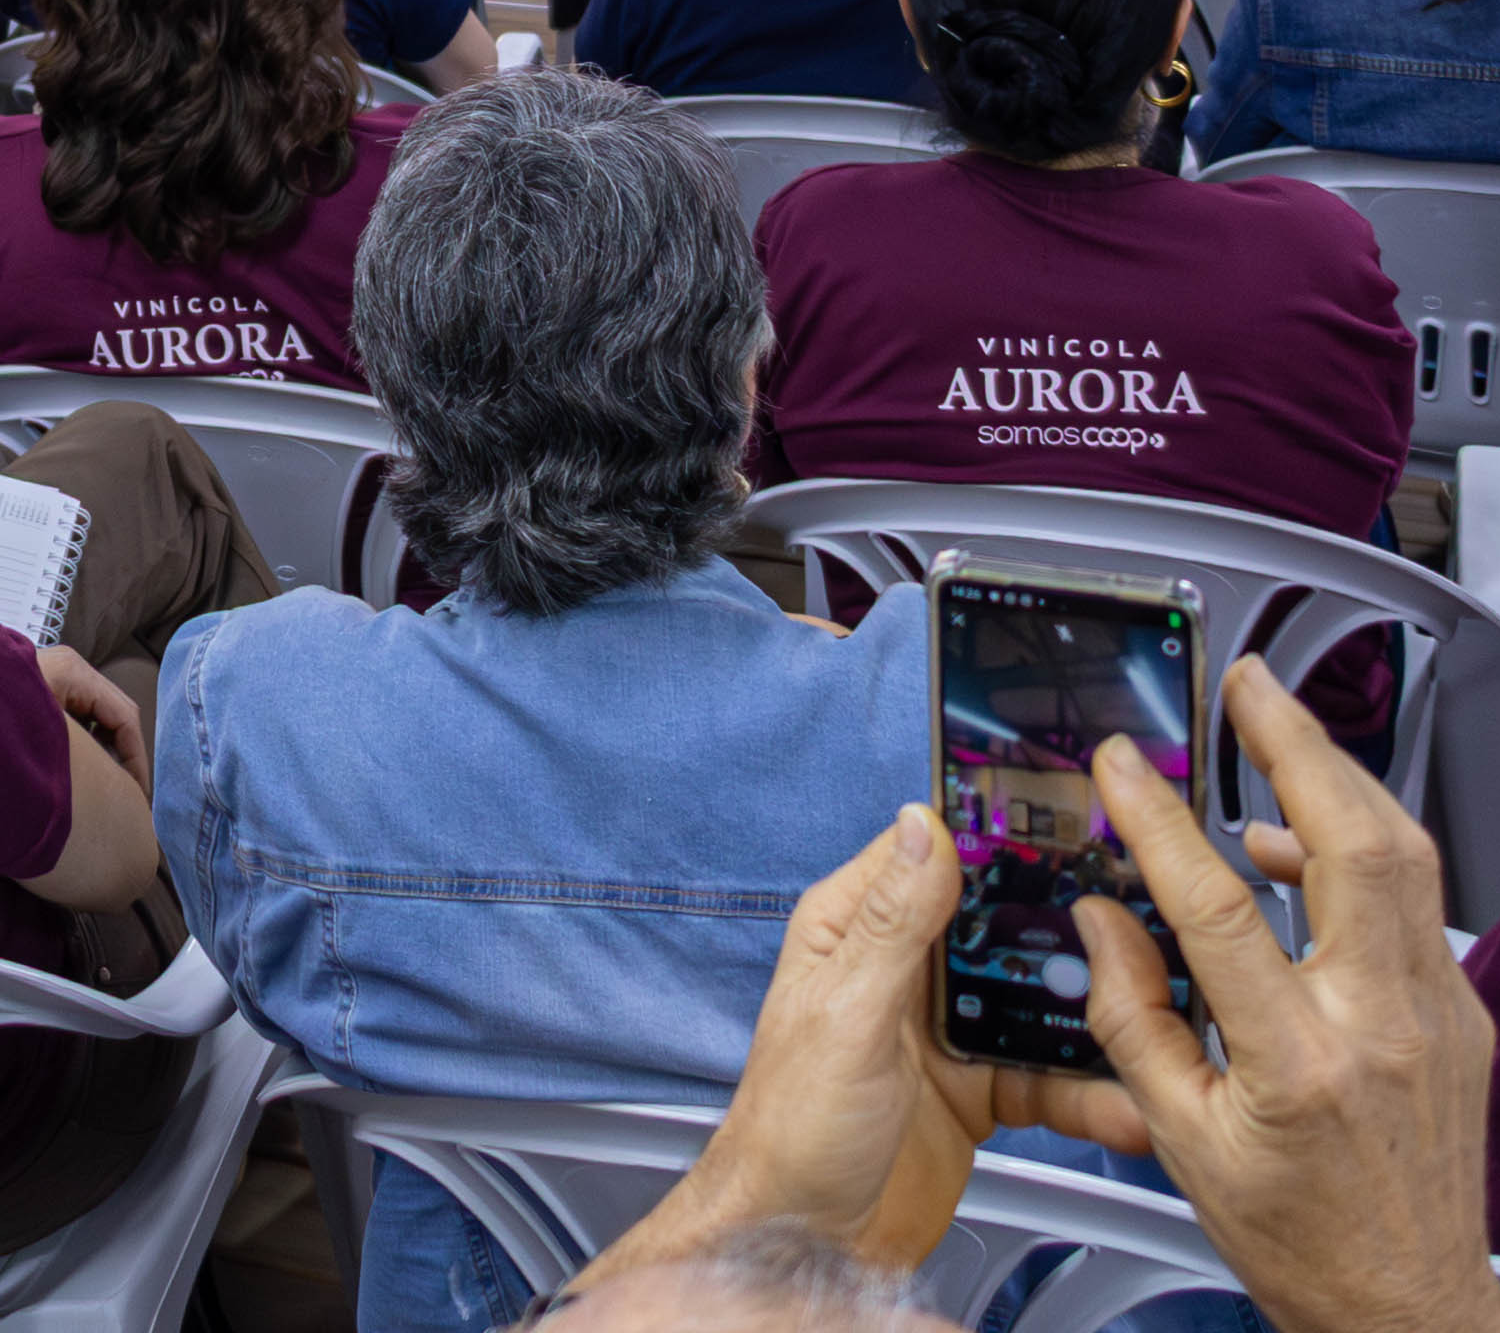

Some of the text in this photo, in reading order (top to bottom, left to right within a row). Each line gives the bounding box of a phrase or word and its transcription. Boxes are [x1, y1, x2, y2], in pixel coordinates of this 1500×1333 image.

[113, 295, 269, 319] VINÍCOLA
[89, 323, 314, 370] AURORA
[977, 335, 1161, 359] VINÍCOLA
[938, 367, 1207, 414] AURORA
